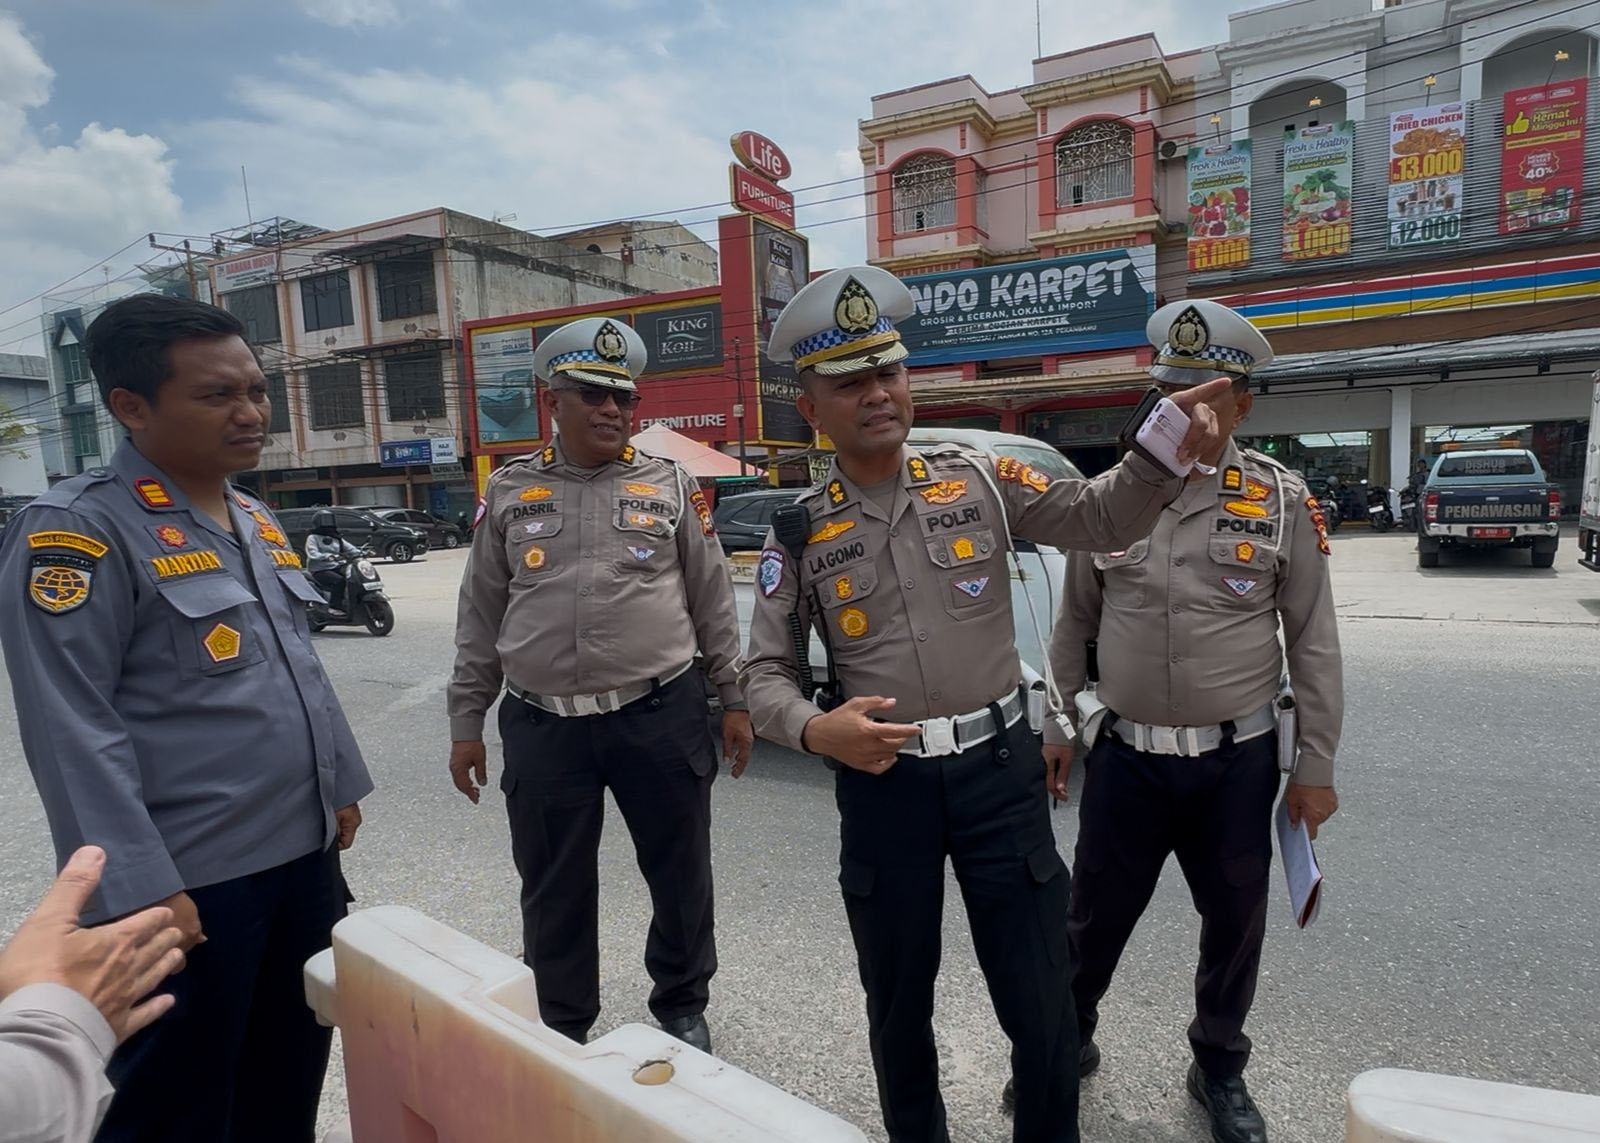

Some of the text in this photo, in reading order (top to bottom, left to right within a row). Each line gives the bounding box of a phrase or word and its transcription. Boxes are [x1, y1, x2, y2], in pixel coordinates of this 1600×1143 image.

[1393, 121, 1419, 132] FRIED
[1421, 113, 1463, 127] CHICKEN
[1533, 109, 1570, 122] Hemat
[1285, 143, 1307, 153] Fresh
[1315, 136, 1349, 150] Healthy
[750, 135, 782, 175] Life
[1216, 155, 1247, 168] Healthy
[1398, 149, 1461, 180] 13.000
[1526, 166, 1553, 179] 40%
[742, 181, 792, 217] FURNITURE
[1397, 215, 1459, 243] 12.000
[909, 258, 1132, 316] NDO KARPET
[920, 315, 955, 327] GROSIR
[967, 311, 1009, 321] ECERAN,
[1012, 306, 1045, 317] LOKAL
[1058, 300, 1097, 311] IMPORT
[667, 317, 708, 333] KING
[762, 382, 804, 400] UPGRAD
[640, 413, 727, 432] FURNITURE
[1465, 459, 1507, 470] DISHUB
[512, 502, 557, 519] DASRIL
[619, 499, 664, 514] POLRI
[1444, 503, 1542, 519] PENGAWASAN
[926, 505, 982, 532] POLRI
[1216, 518, 1274, 538] POLRI
